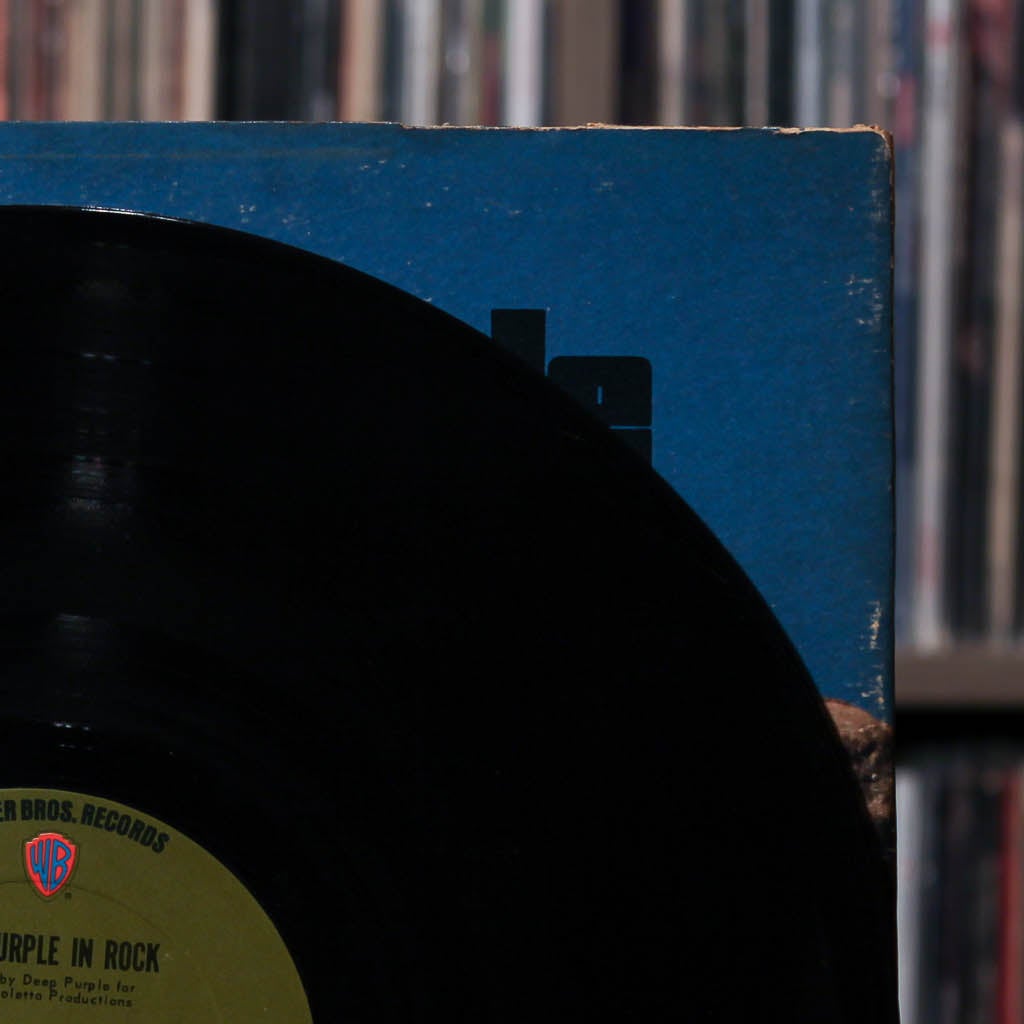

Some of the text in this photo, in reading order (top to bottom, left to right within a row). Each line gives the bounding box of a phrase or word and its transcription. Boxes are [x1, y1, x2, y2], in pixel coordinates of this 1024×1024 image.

[20, 798, 76, 824] BROS.
[80, 803, 171, 853] RECORDS
[29, 837, 73, 891] WB
[71, 937, 95, 968] IN
[103, 939, 161, 973] ROCK
[0, 973, 16, 987] by
[22, 974, 57, 990] Deep
[63, 976, 111, 993] Purple
[116, 979, 136, 993] for
[48, 989, 133, 1008] Productions
